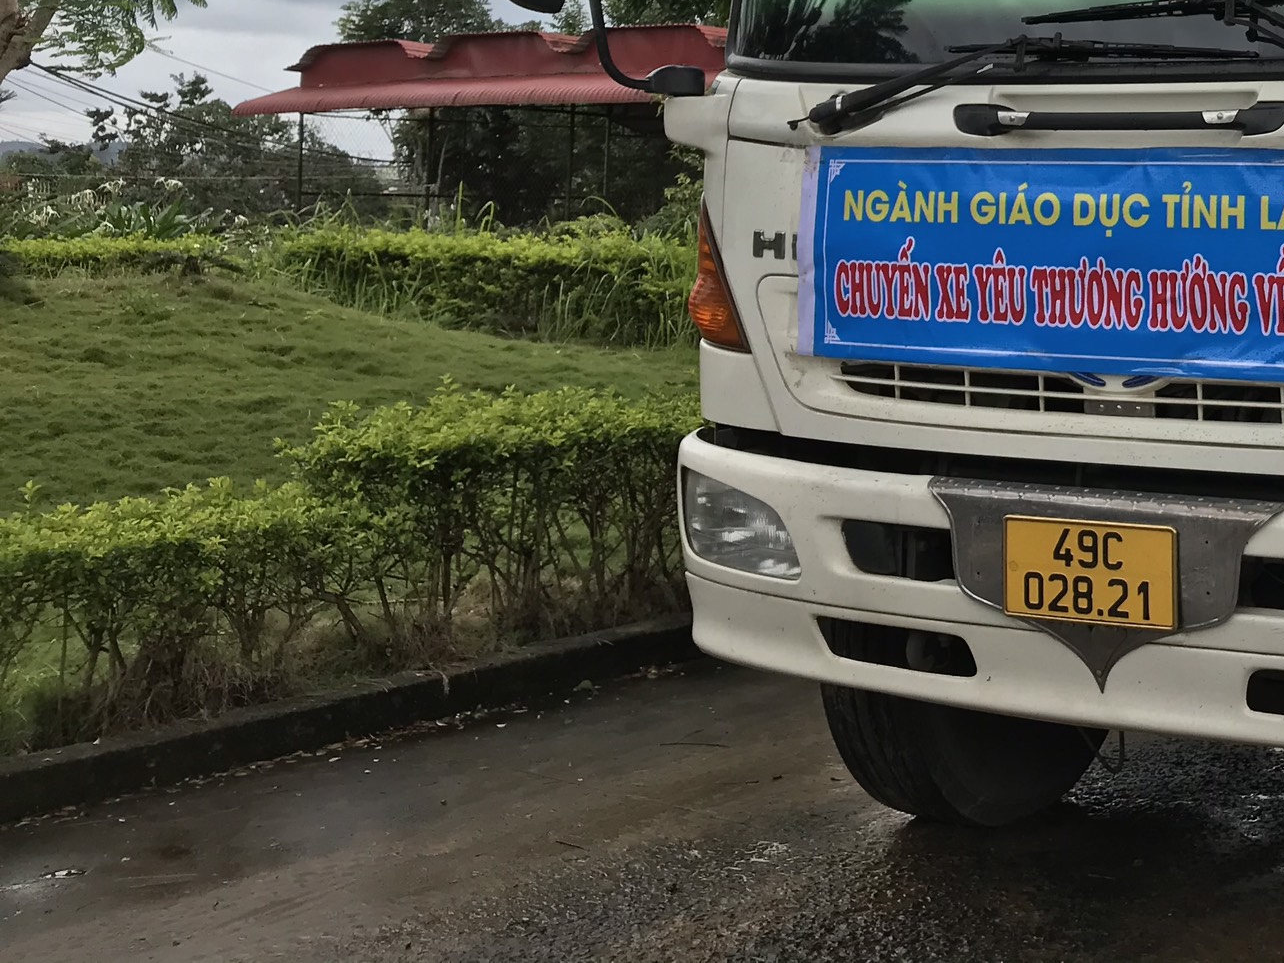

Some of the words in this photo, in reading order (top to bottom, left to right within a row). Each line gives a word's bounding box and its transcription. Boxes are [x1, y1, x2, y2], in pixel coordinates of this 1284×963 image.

[843, 180, 959, 224] NGÀNH
[969, 182, 1061, 227] GIÁO
[1072, 192, 1150, 238] DỤC
[1161, 181, 1246, 230] TỈNH
[834, 236, 931, 322] CHUYẾN
[934, 262, 972, 323] XE
[972, 247, 1027, 325] YÊU
[1030, 253, 1145, 331] THƯƠNG
[1147, 253, 1251, 335] HƯỚNG
[1052, 528, 1124, 571] 49C
[1023, 571, 1151, 621] 028.21
